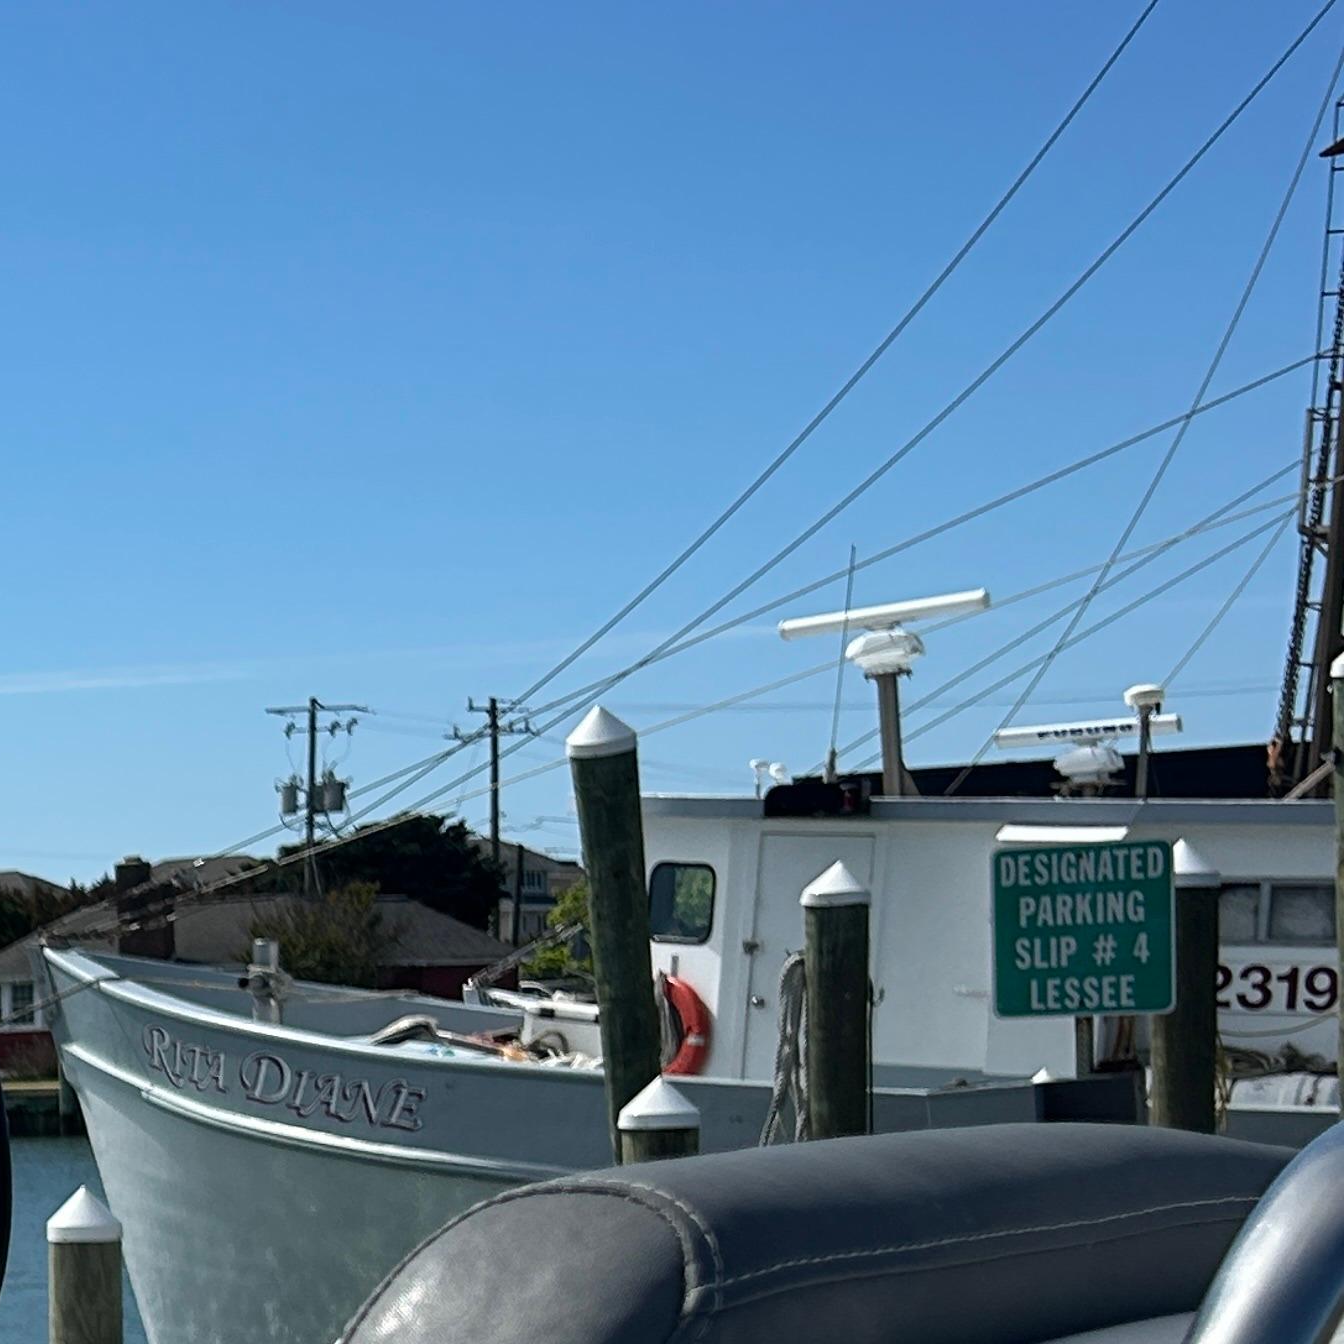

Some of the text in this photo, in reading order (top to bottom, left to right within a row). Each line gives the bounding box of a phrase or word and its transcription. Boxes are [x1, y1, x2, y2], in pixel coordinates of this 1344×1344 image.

[1000, 846, 1165, 888] DESIGNATED
[1019, 890, 1146, 928] PARKING
[1015, 932, 1151, 969] SLIP # 4
[1029, 974, 1136, 1011] LESSEE
[142, 1023, 428, 1133] RITA DIANE
